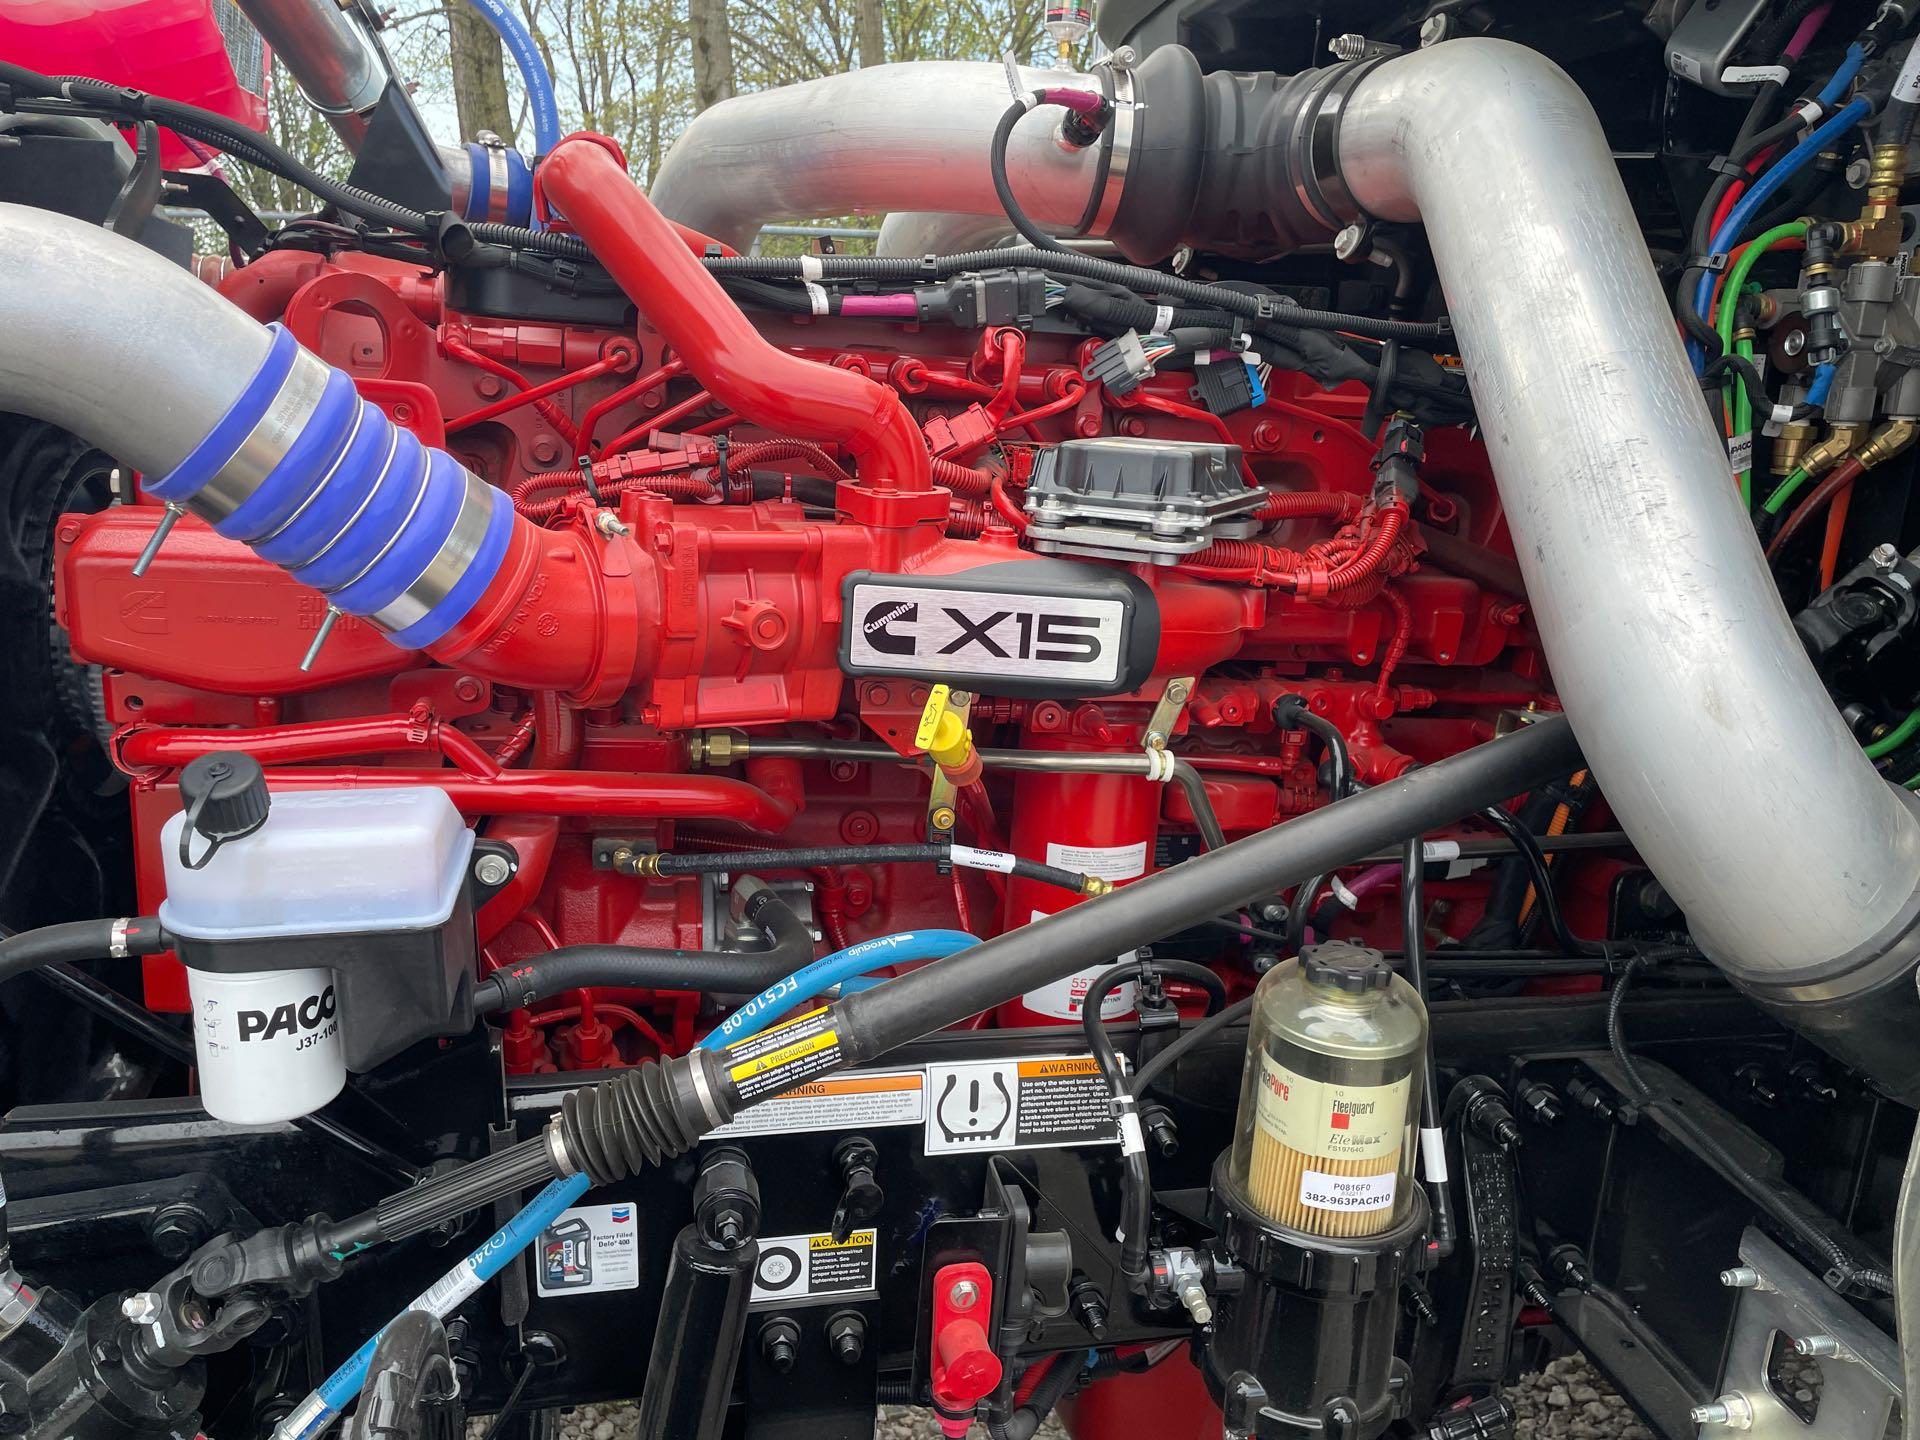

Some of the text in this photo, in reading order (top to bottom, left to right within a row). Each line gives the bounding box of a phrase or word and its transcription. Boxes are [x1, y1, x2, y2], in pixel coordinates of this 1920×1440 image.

[482, 625, 518, 654] MADE
[514, 609, 529, 624] IN
[526, 574, 548, 608] INDIA
[864, 602, 1101, 663] Cummins X15
[848, 934, 914, 956] Aeroquip
[804, 959, 832, 974] Danfoss
[722, 976, 798, 1034] FC510-08
[1048, 1061, 1099, 1073] WARNING
[1022, 1081, 1033, 1089] Use
[1034, 1080, 1047, 1088] only
[1059, 1078, 1075, 1086] wheel
[1053, 1092, 1091, 1100] manufacturer.
[1332, 1100, 1374, 1116] Fleetguard
[1334, 1182, 1370, 1191] P0816F0
[1305, 1192, 1391, 1206] 382-963PACR10
[822, 1235, 871, 1246] CATION
[467, 1246, 492, 1270] 240
